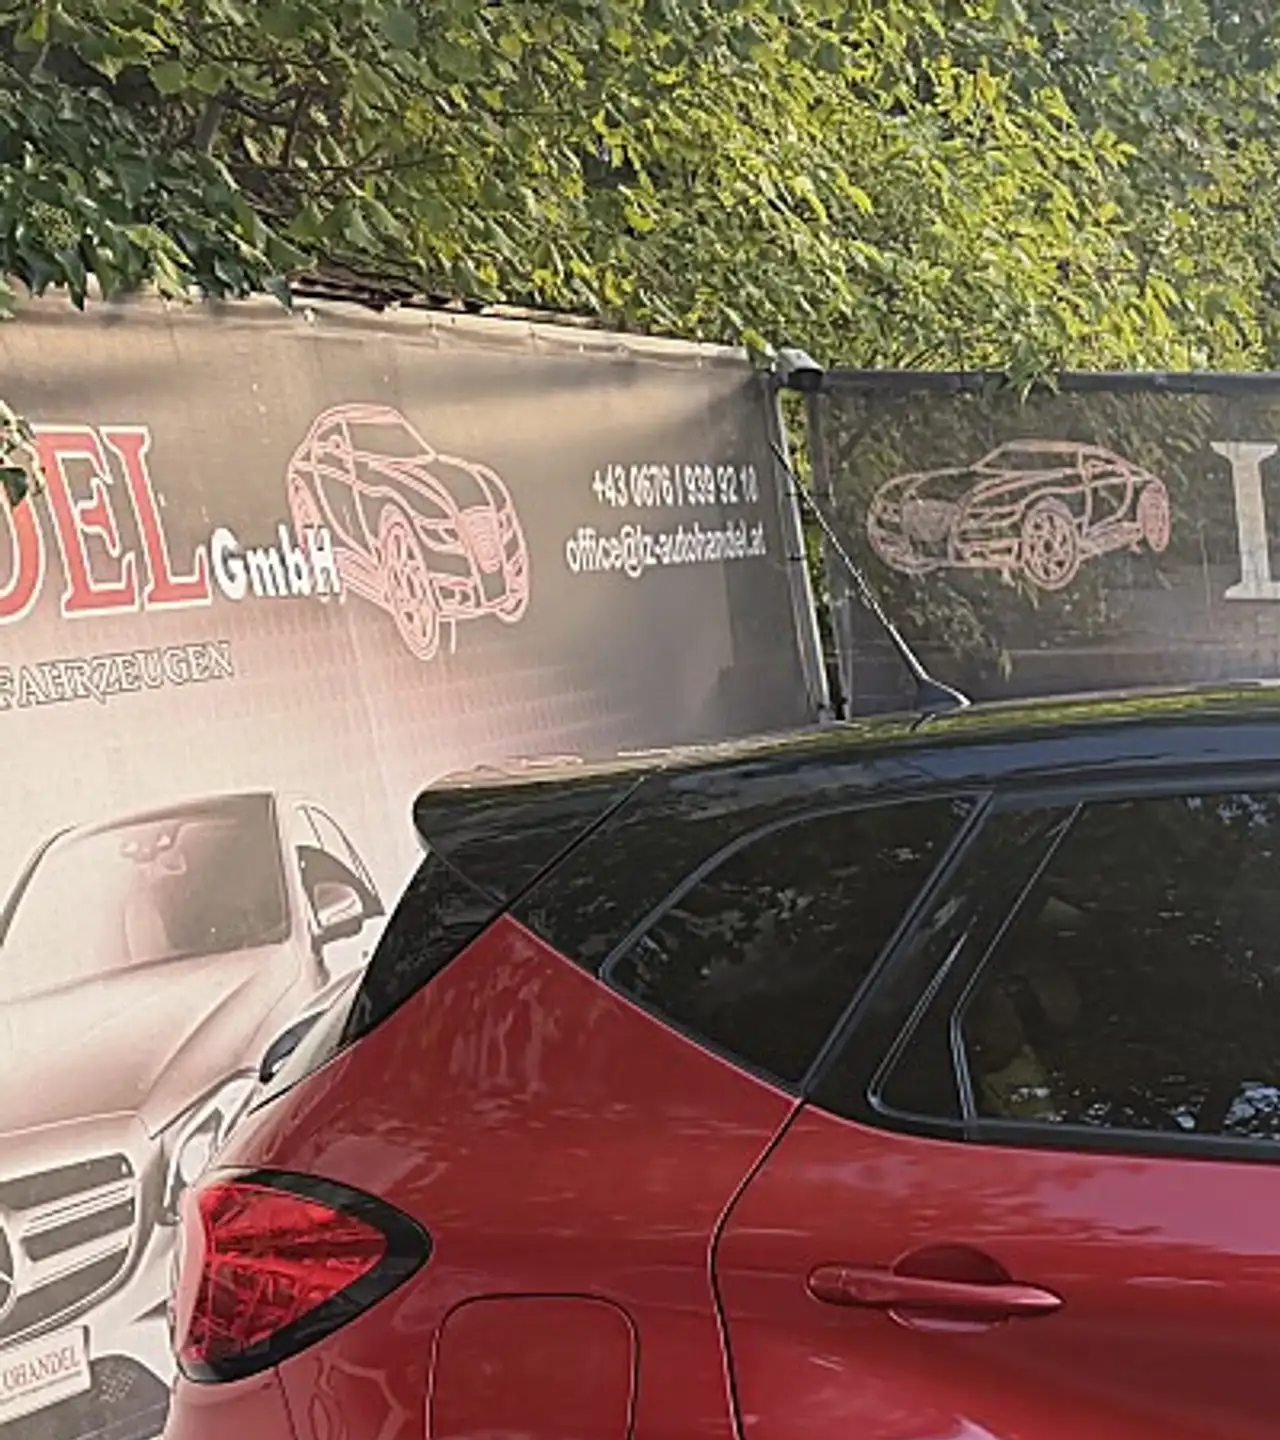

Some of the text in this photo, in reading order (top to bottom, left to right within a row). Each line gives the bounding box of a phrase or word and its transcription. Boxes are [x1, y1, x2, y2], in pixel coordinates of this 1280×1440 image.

[592, 464, 628, 507] +43
[630, 464, 673, 507] 0676
[717, 464, 738, 504] 92
[211, 525, 341, 600] GmbH
